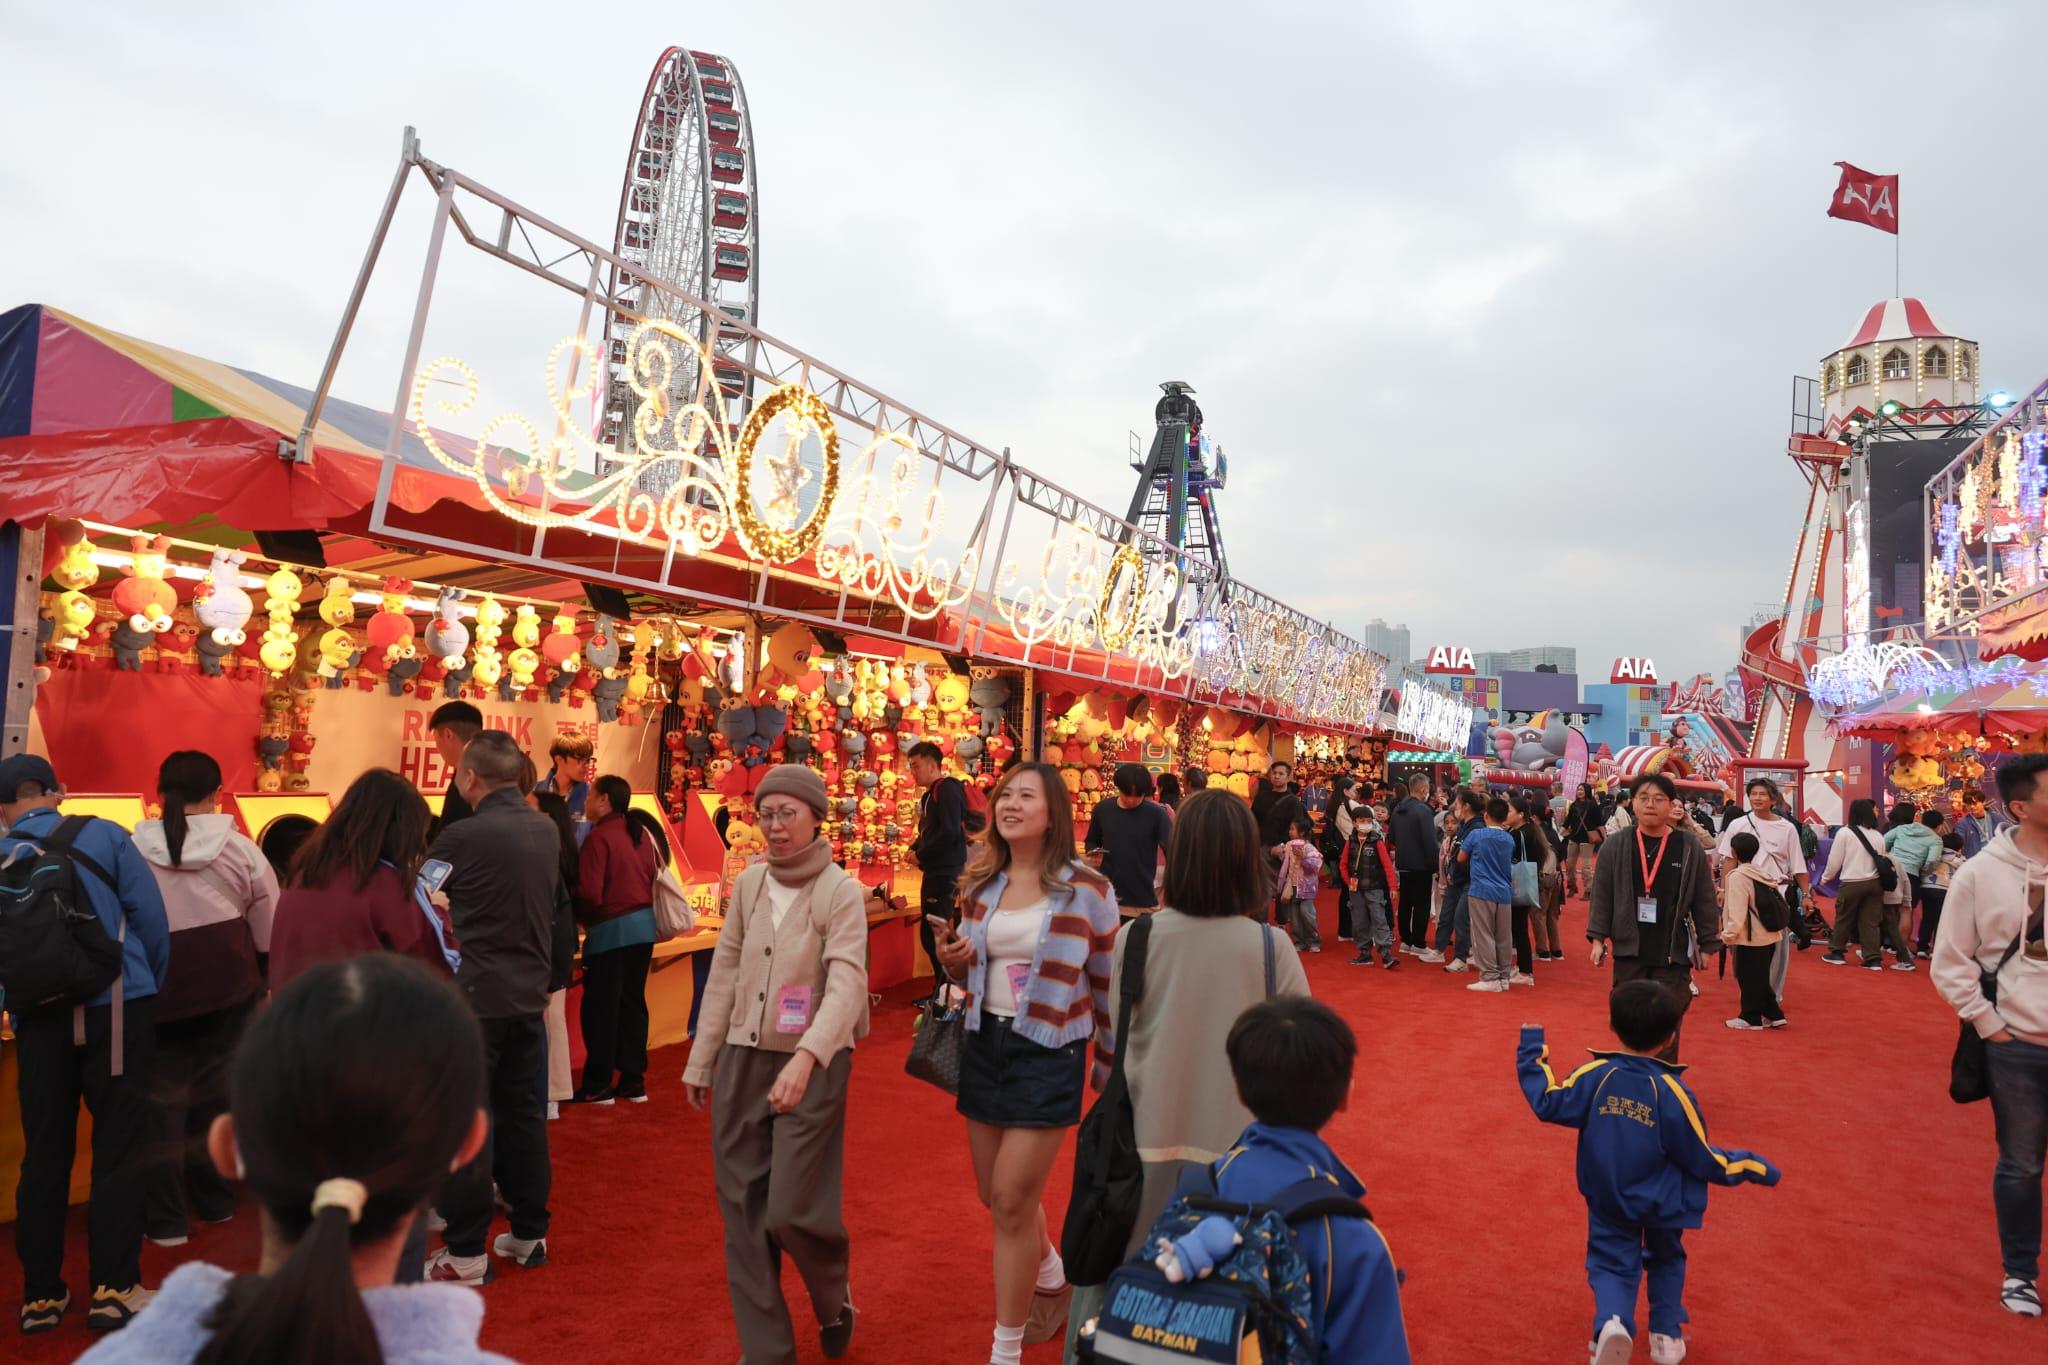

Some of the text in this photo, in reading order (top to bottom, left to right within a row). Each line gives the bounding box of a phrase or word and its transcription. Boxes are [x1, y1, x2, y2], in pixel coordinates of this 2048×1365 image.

[1430, 646, 1476, 670] AIA
[1617, 656, 1658, 680] AIA
[1131, 1322, 1198, 1352] BATMAN
